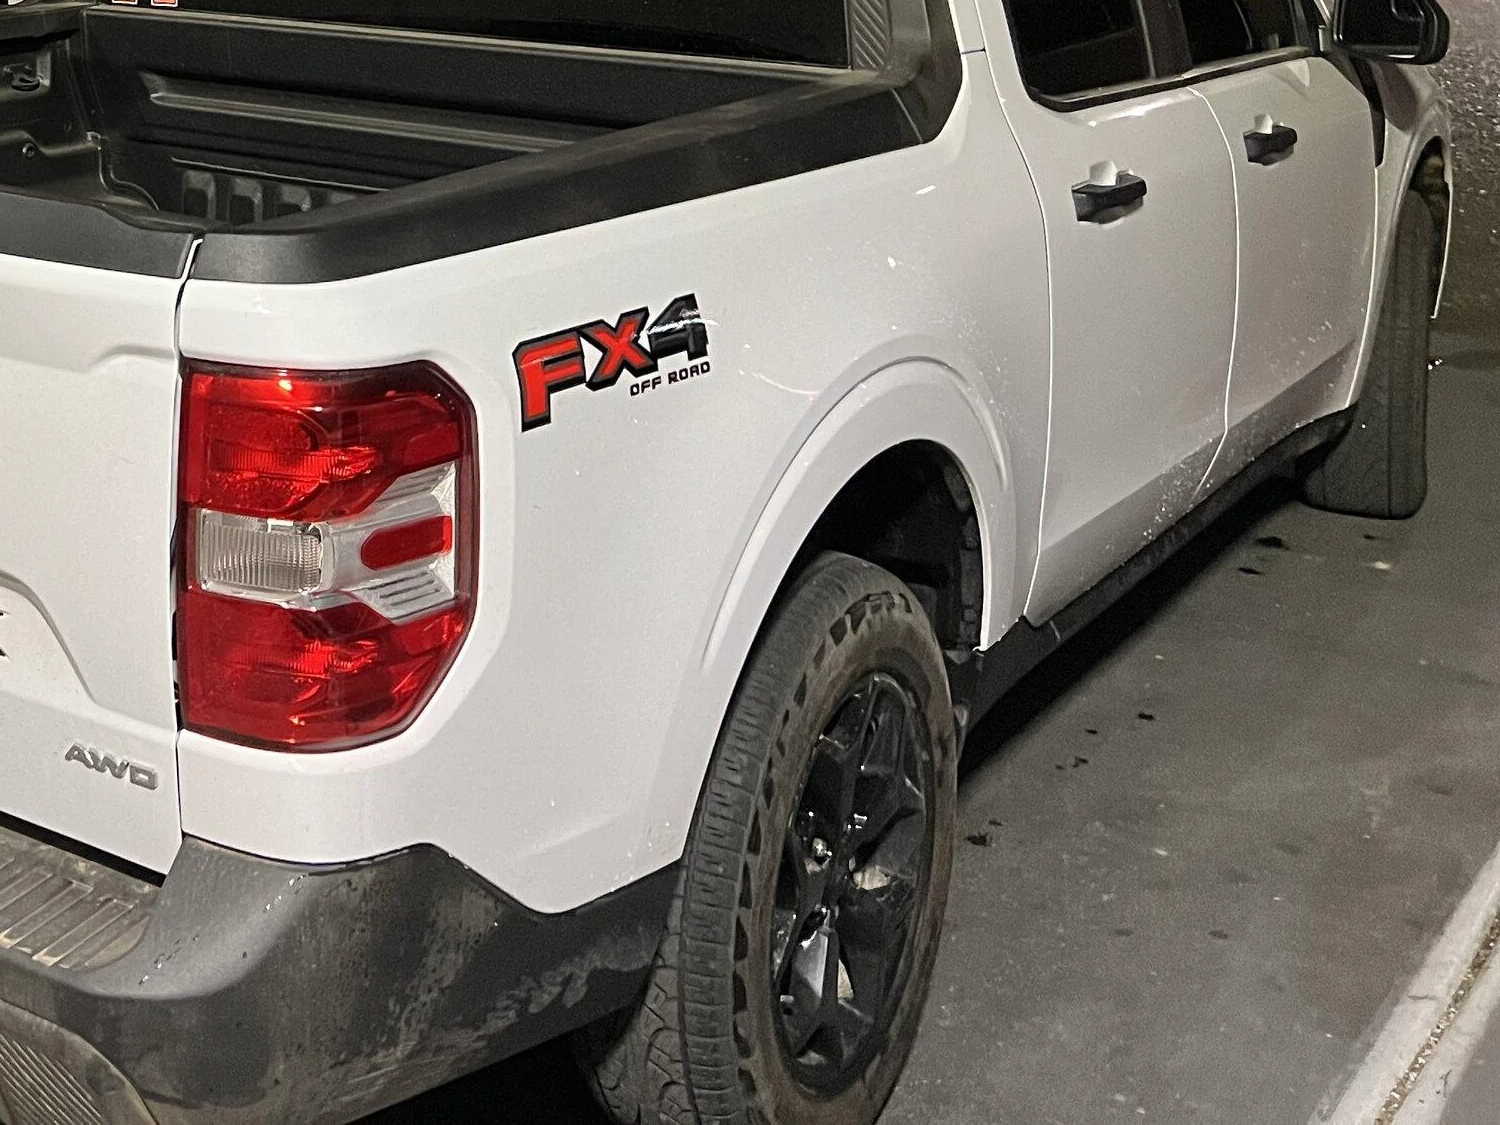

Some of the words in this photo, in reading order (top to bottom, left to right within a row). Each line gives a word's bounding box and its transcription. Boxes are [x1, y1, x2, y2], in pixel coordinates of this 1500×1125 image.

[512, 293, 709, 433] FX4
[629, 376, 661, 397] OFF
[668, 361, 711, 385] ROAD
[64, 742, 158, 791] AWD
